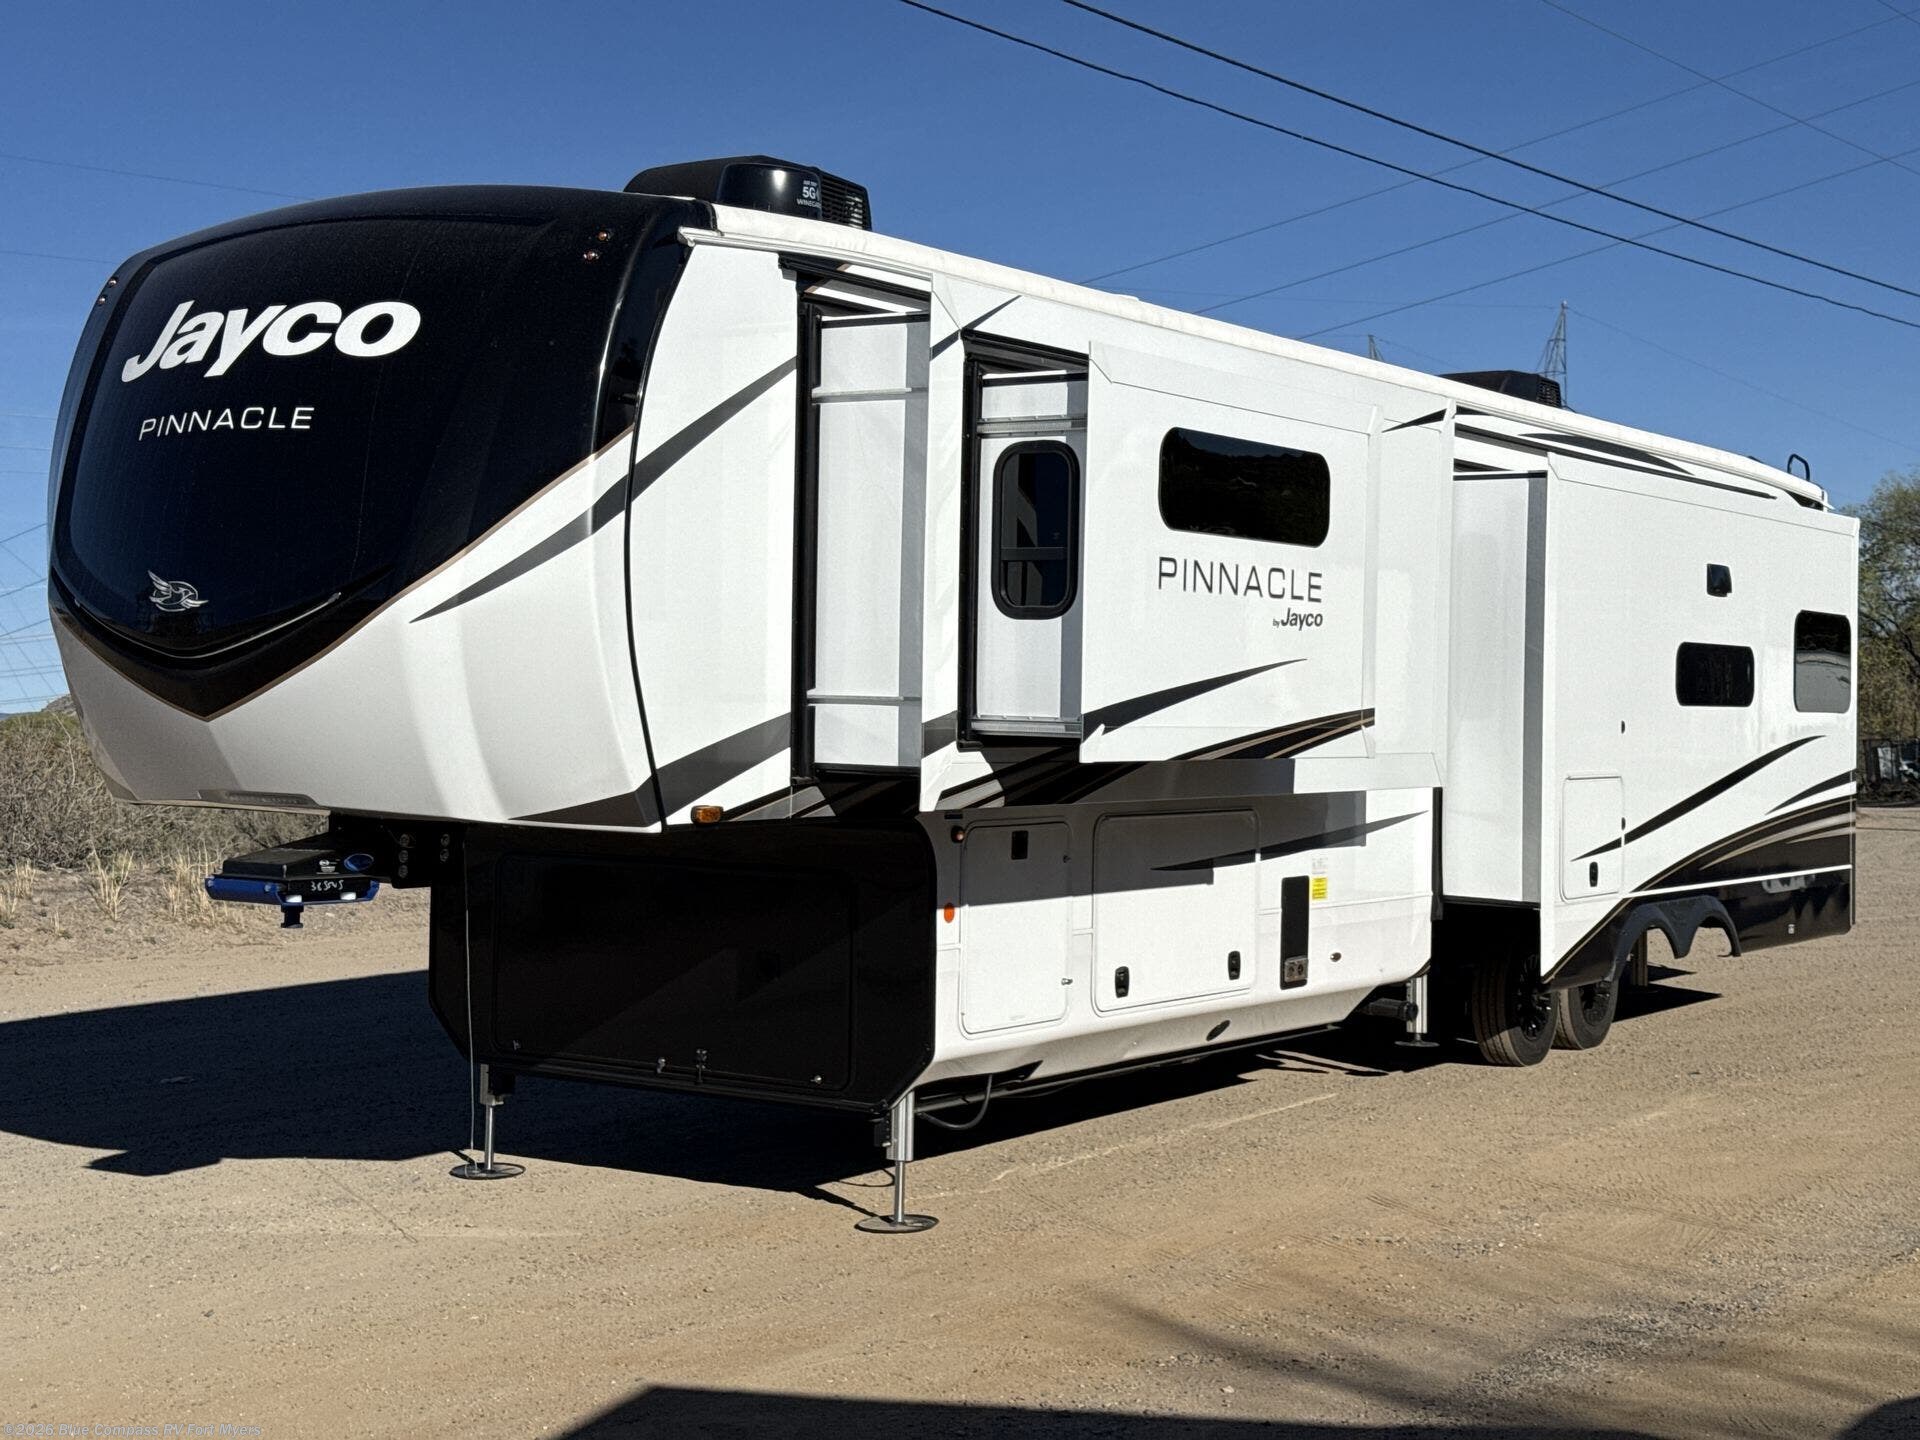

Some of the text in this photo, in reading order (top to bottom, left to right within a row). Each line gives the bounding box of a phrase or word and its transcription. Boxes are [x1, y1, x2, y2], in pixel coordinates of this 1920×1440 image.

[802, 186, 816, 199] 5G
[122, 300, 422, 383] Jayco
[139, 407, 315, 441] PINNACLE
[1158, 556, 1323, 603] PINNACLE
[1272, 607, 1323, 631] by Jayco
